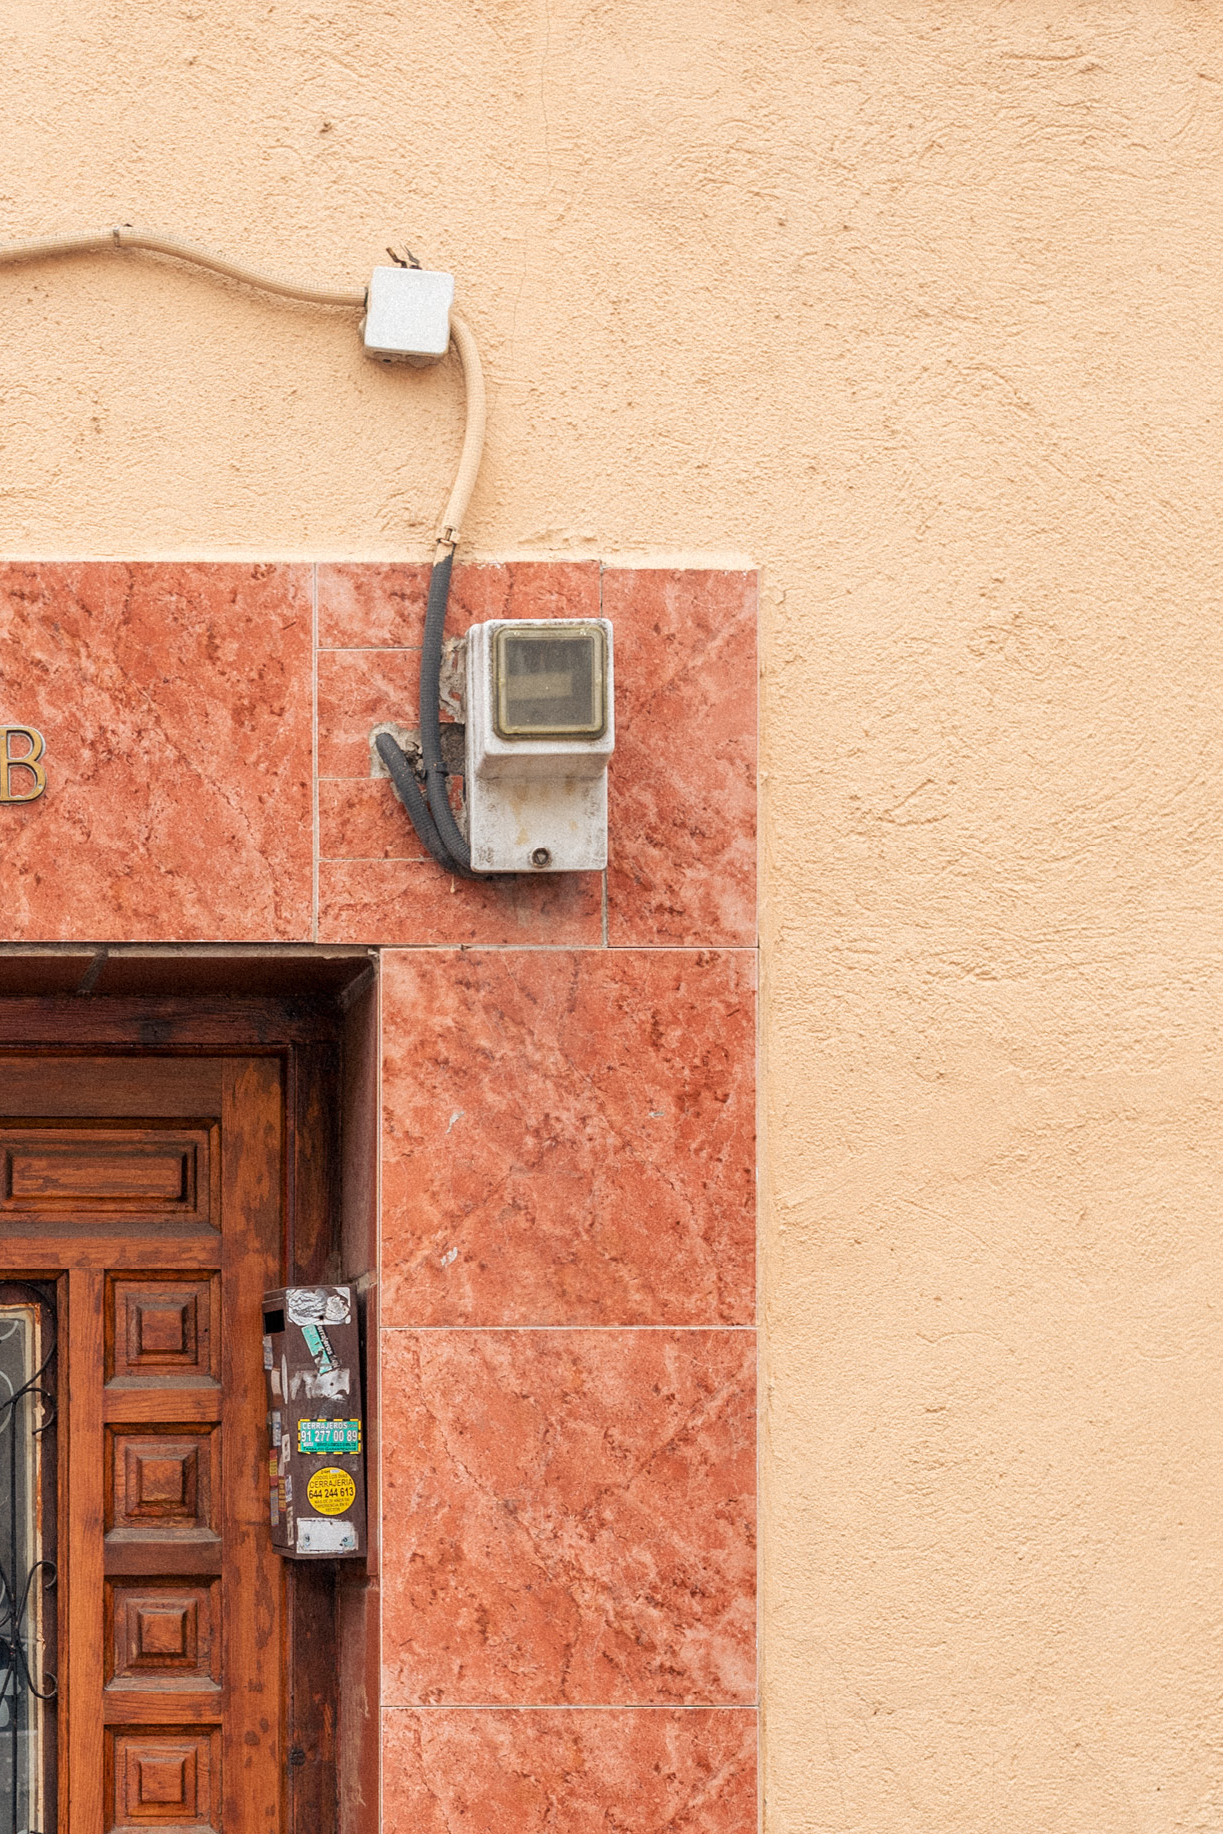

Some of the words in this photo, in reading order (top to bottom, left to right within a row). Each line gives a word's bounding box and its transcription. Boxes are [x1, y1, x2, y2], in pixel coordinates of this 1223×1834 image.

[302, 1422, 348, 1430] CERRAJEROS
[301, 1430, 311, 1442] 91
[314, 1430, 331, 1442] 277
[333, 1430, 344, 1442] 00
[347, 1430, 358, 1442] 89
[309, 1490, 322, 1499] 644
[325, 1488, 338, 1498] 244
[340, 1487, 354, 1497] 613
